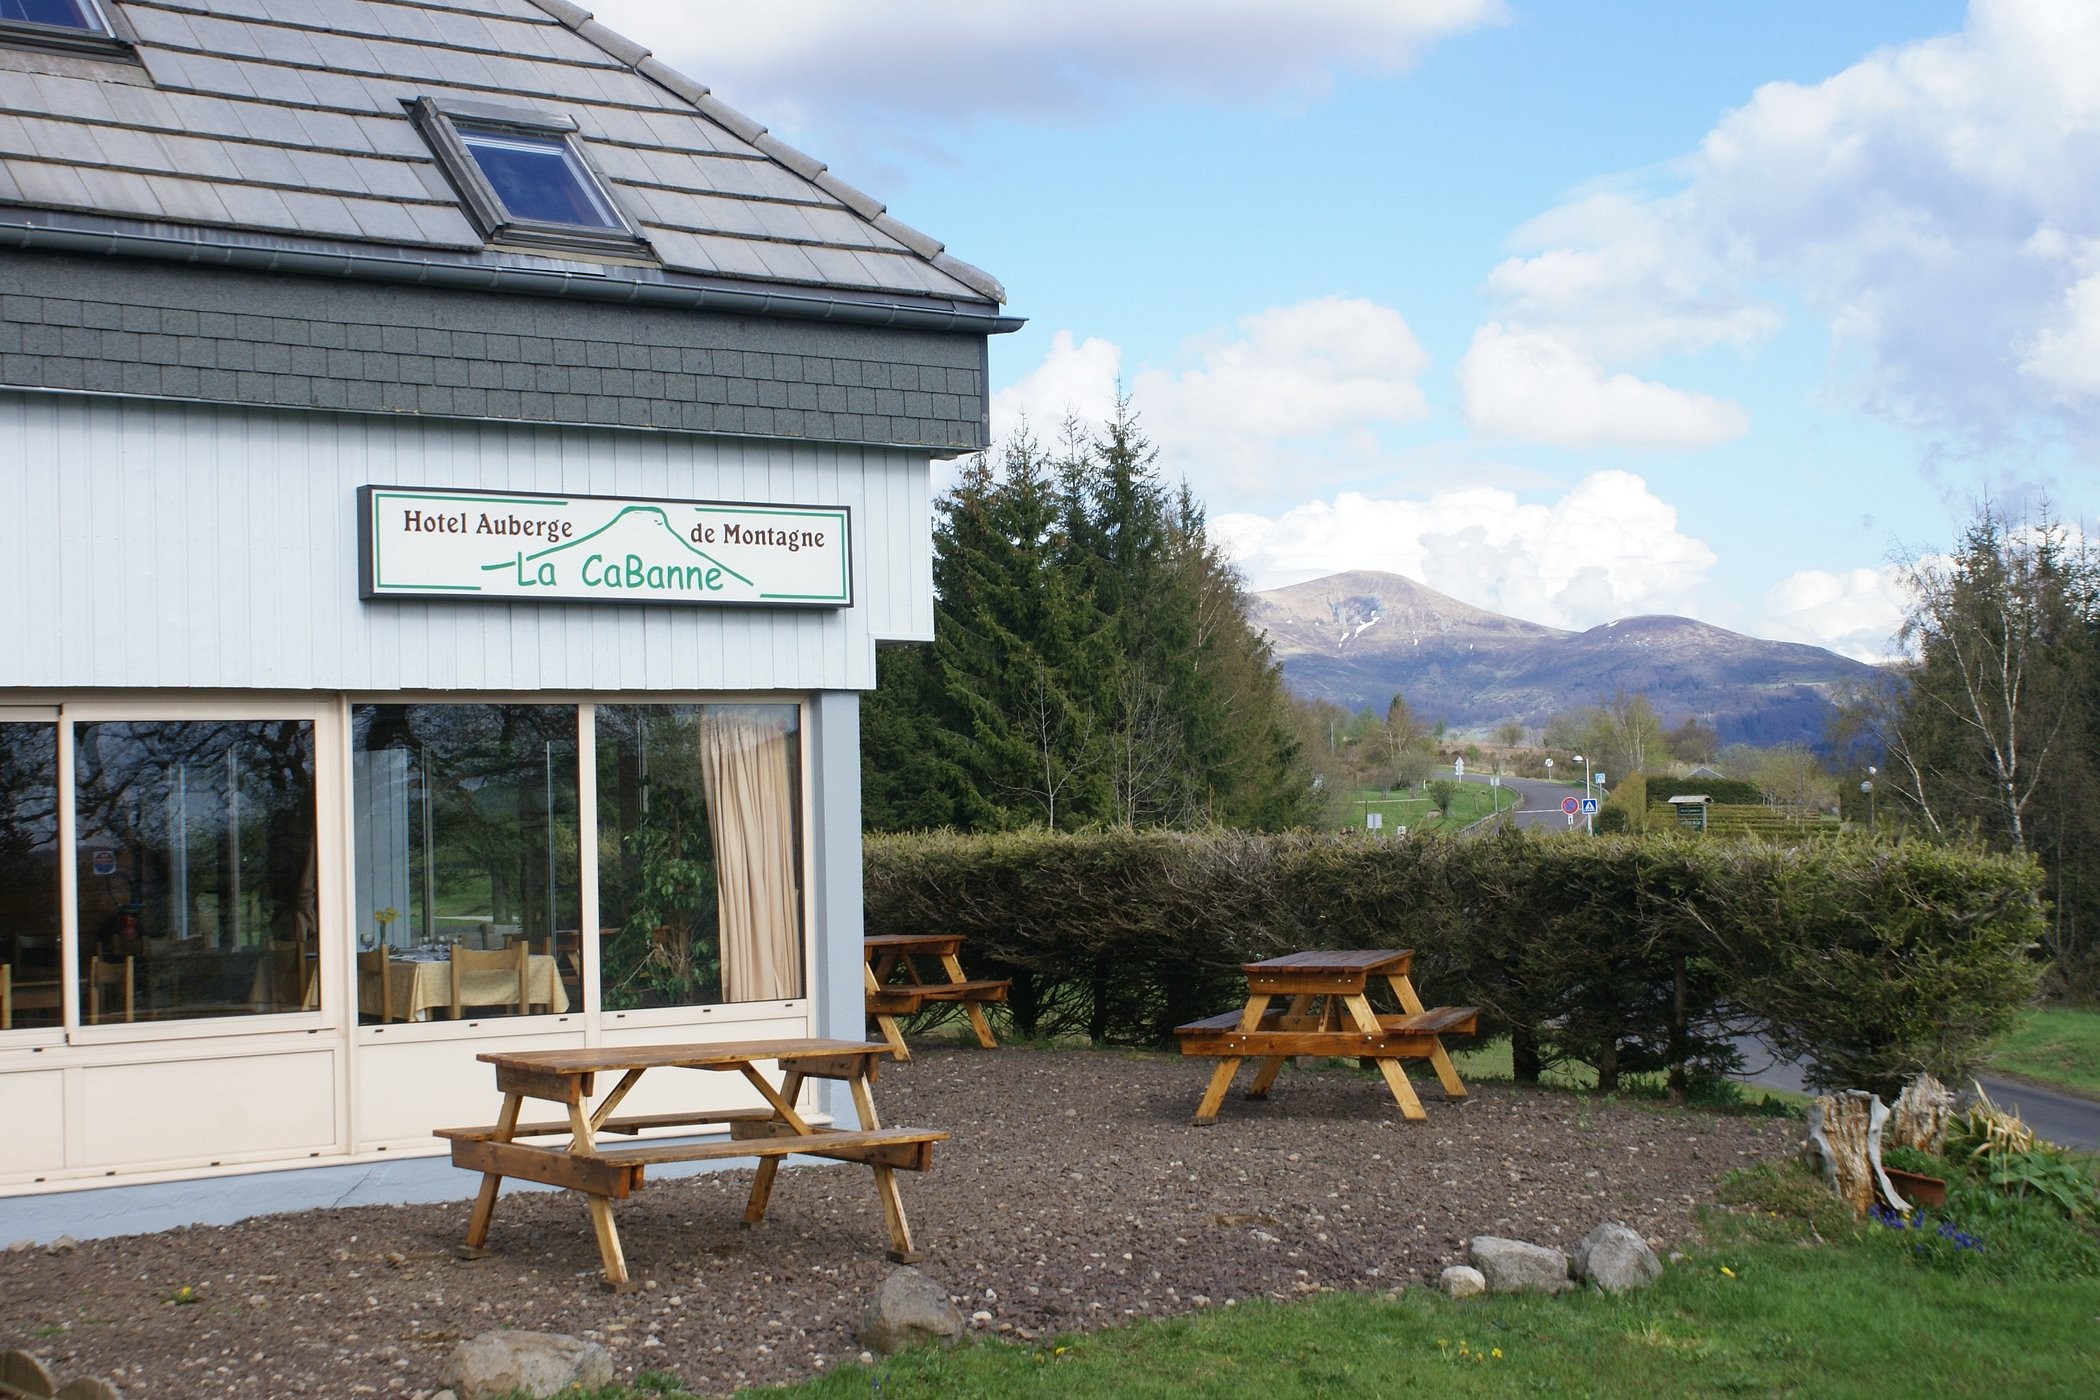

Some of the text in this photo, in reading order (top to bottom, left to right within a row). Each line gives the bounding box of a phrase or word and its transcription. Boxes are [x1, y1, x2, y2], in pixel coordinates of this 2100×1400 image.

[404, 509, 825, 551] Hotel Auberge de Montagne
[517, 551, 724, 591] La CaBanne
